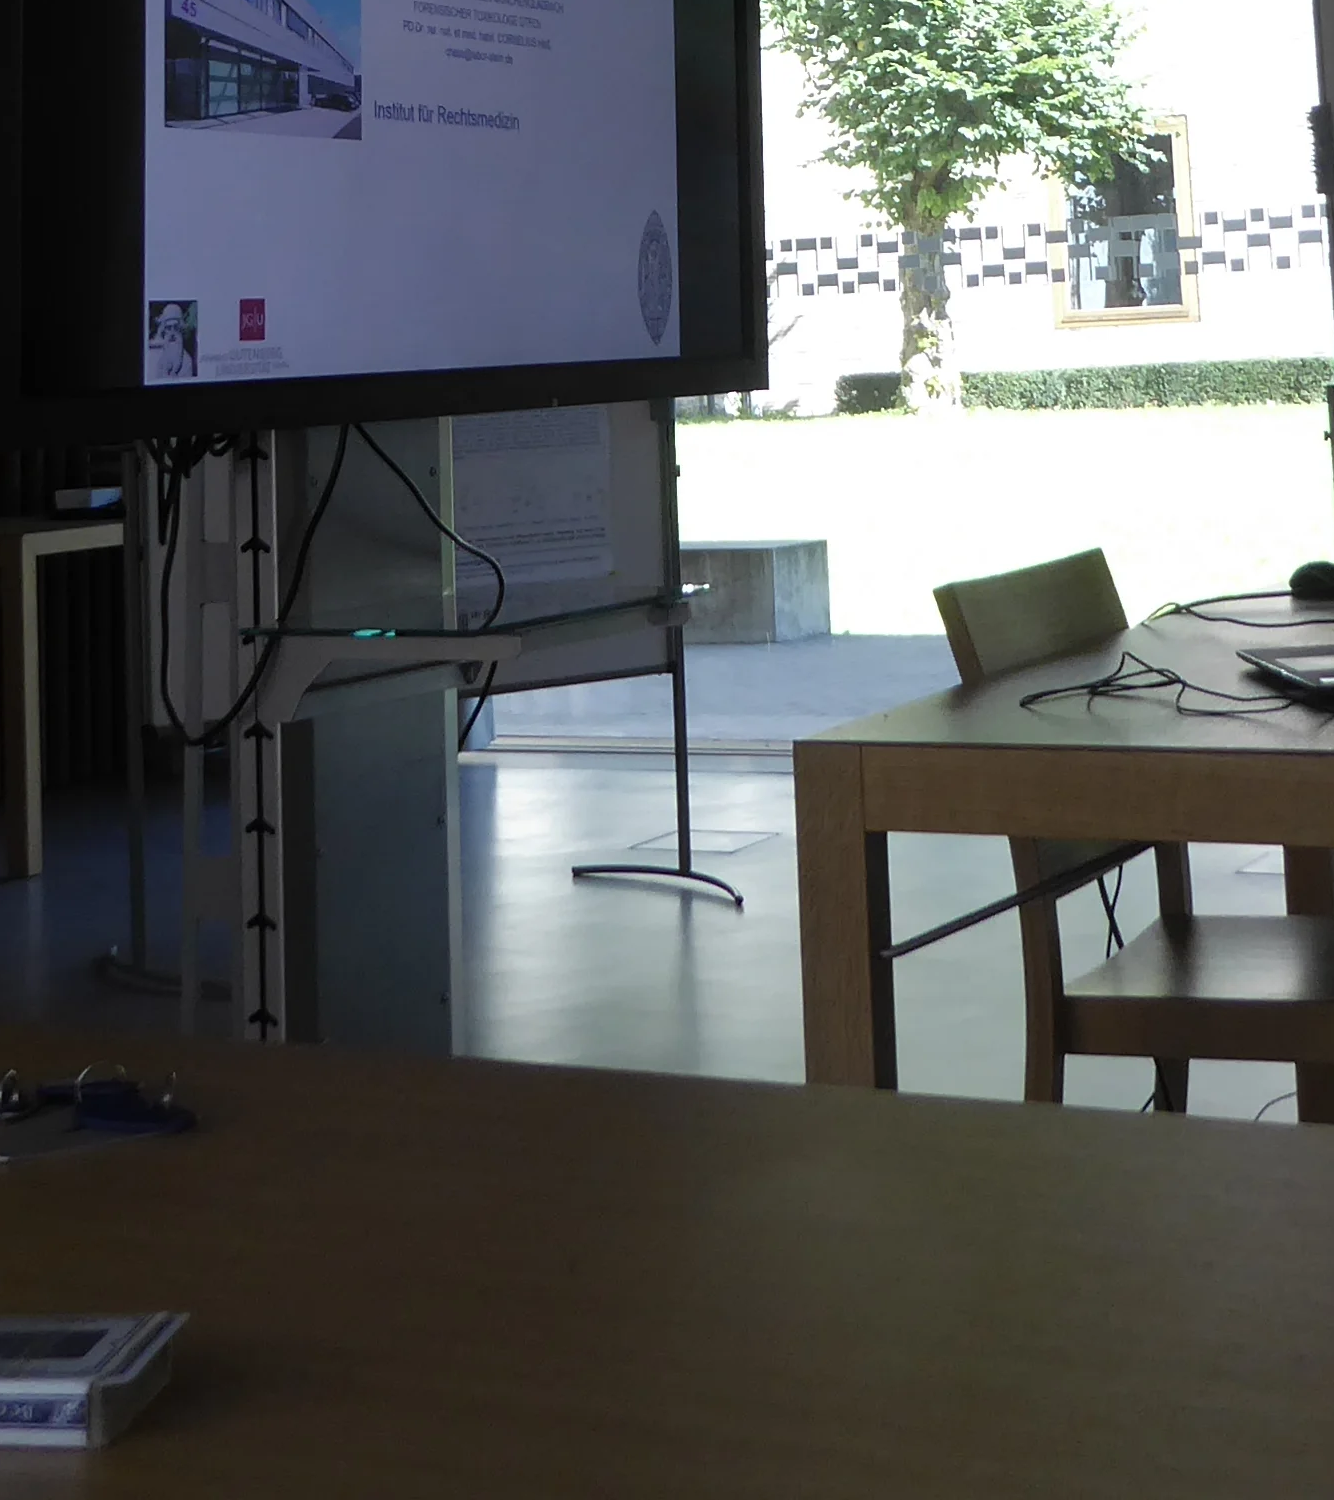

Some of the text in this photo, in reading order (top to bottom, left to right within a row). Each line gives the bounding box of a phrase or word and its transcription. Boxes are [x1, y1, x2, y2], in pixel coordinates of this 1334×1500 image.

[374, 100, 520, 131] Institut für Rechtsmedizin
